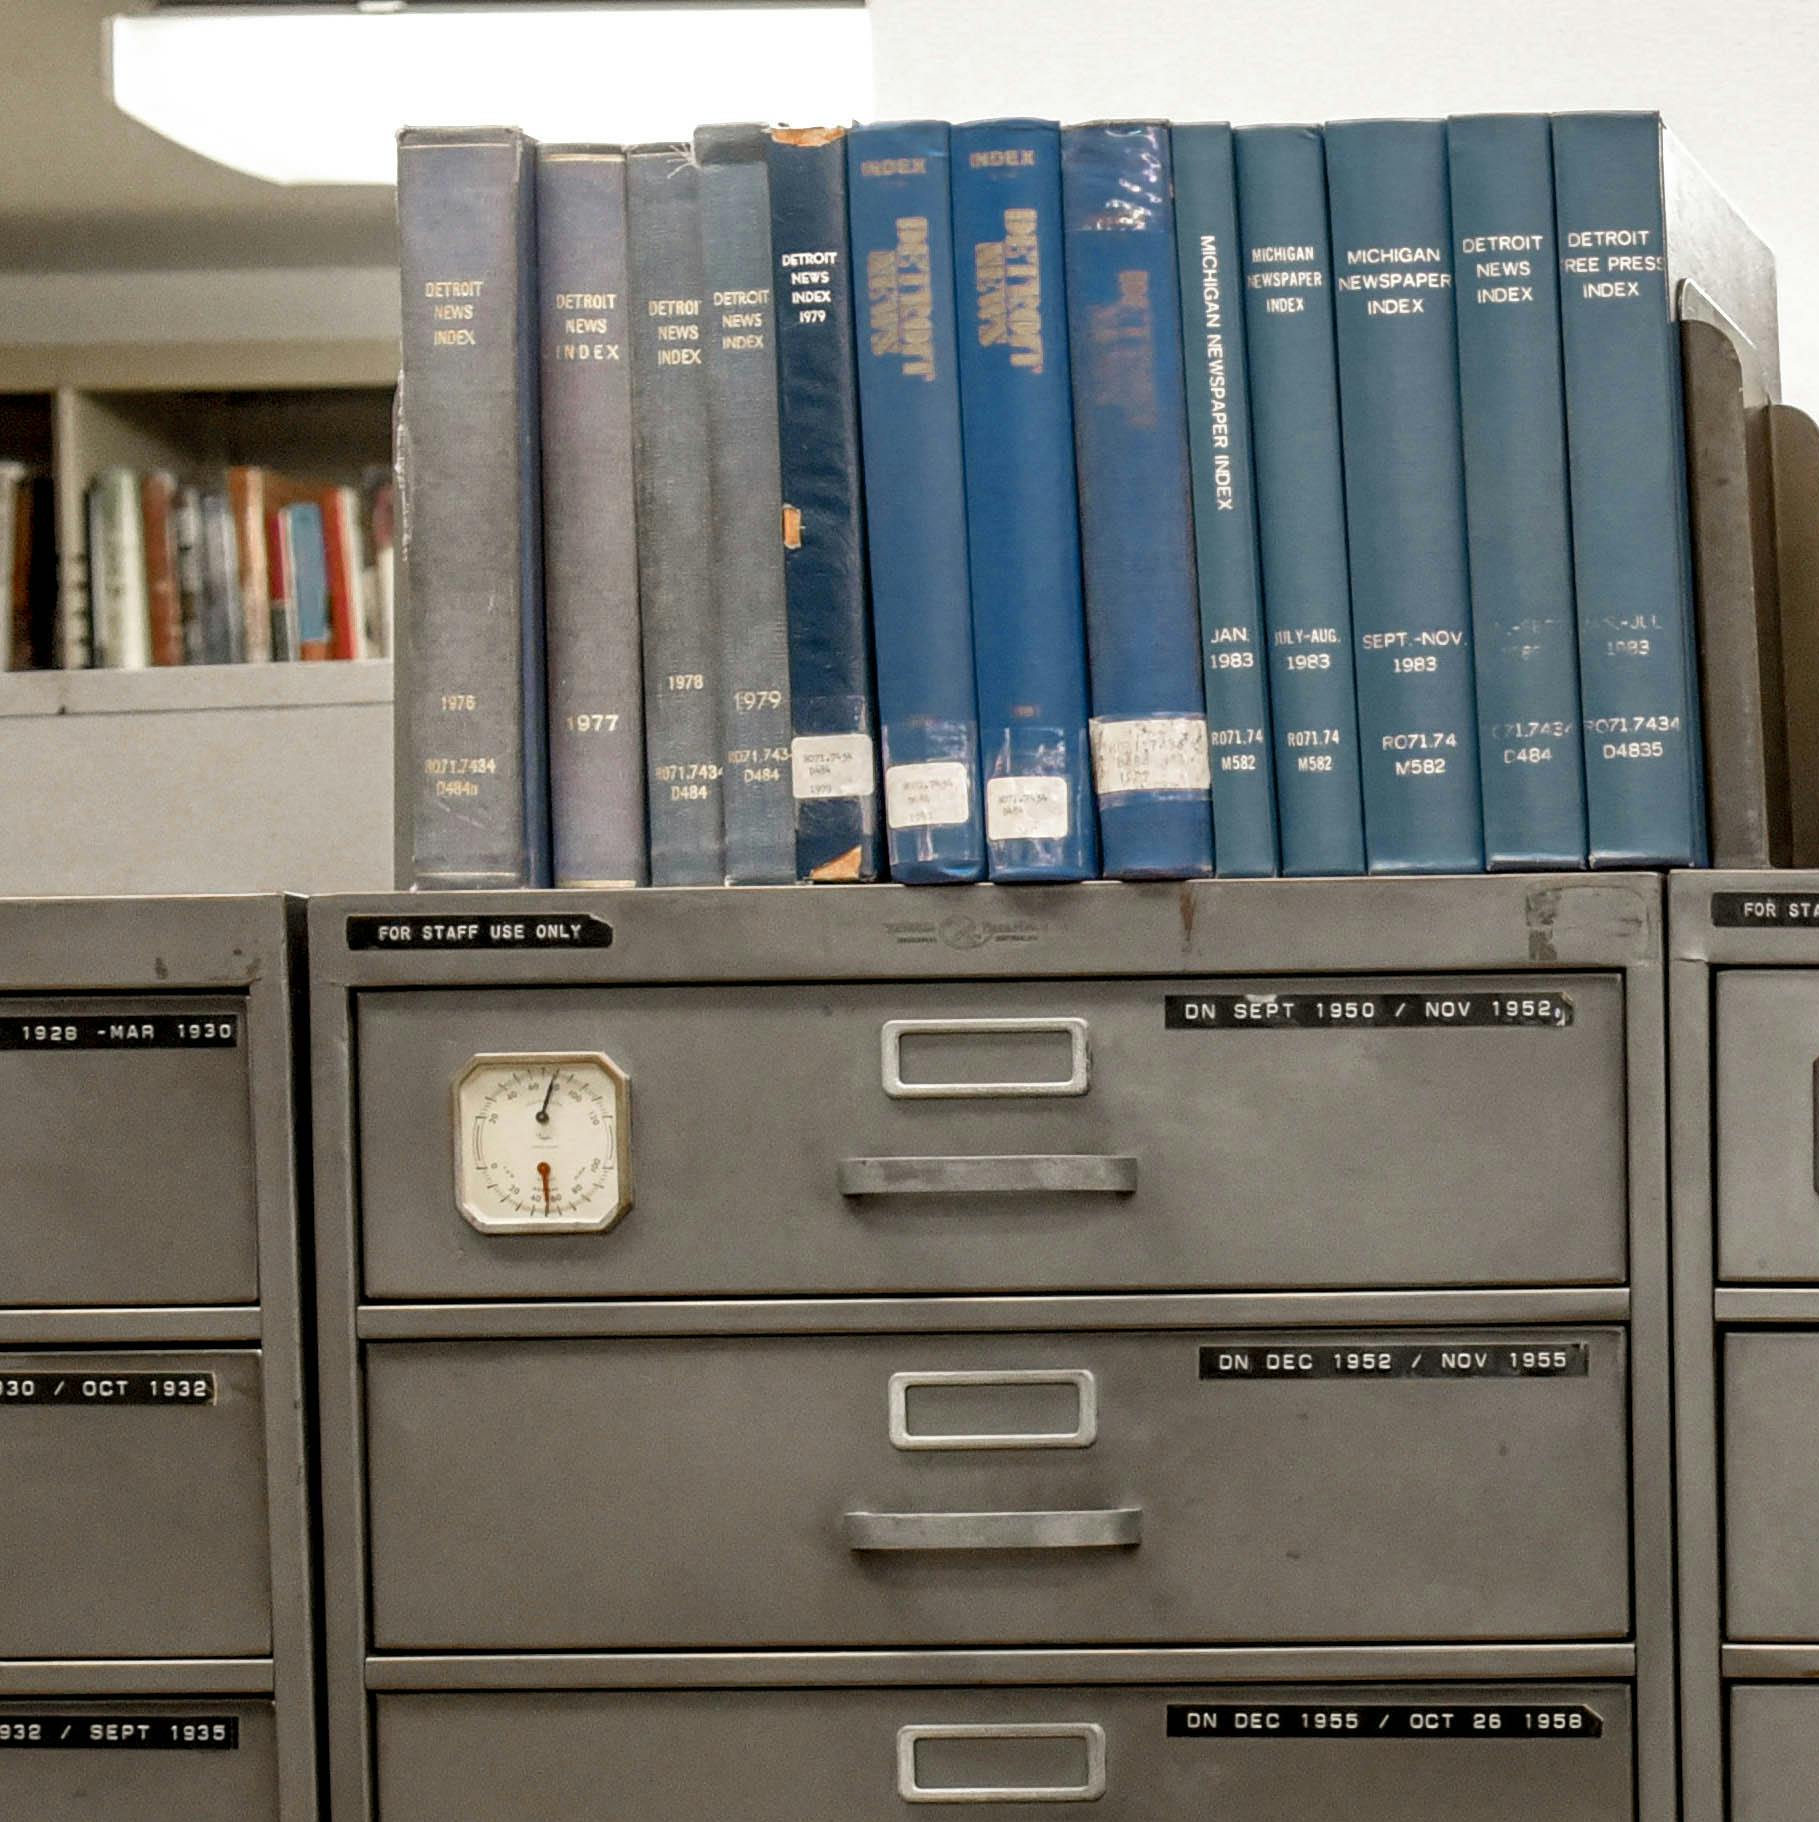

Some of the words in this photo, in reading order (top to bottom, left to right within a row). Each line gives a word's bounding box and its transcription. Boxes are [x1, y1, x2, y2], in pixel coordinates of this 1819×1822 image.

[1462, 235, 1543, 253] DETROIT
[782, 251, 838, 267] DETROIT
[1347, 247, 1441, 264] MICHIGAN
[791, 270, 830, 285] NEWS
[1476, 260, 1531, 278] NEWS
[1200, 235, 1221, 328] MICHIGAN
[1339, 273, 1451, 290] NEWSPAPER
[791, 290, 832, 304] INDEX
[1477, 286, 1533, 303] INDEX
[1367, 298, 1424, 315] INDEX
[799, 309, 826, 324] 1979
[1206, 334, 1229, 449] NEWSPAPER
[1214, 454, 1233, 510] INDEX
[1394, 656, 1437, 673] 1983
[1744, 898, 1777, 917] FOR
[378, 925, 411, 941] FOR
[422, 923, 479, 941] STAFF
[490, 923, 525, 939] USE
[535, 924, 582, 939] ONLY
[1185, 1003, 1216, 1020] DN
[1234, 1003, 1295, 1020] SEPT
[1316, 1001, 1375, 1019] 1950
[1425, 1001, 1471, 1018] NOV
[1492, 999, 1551, 1017] 1952
[22, 1025, 77, 1042] 1928
[177, 1023, 232, 1039] 1930
[1219, 1354, 1249, 1370] DN
[1266, 1353, 1313, 1370] DEC
[1334, 1352, 1392, 1369] 1952
[1441, 1352, 1487, 1369] NOV
[1510, 1351, 1567, 1368] 1955
